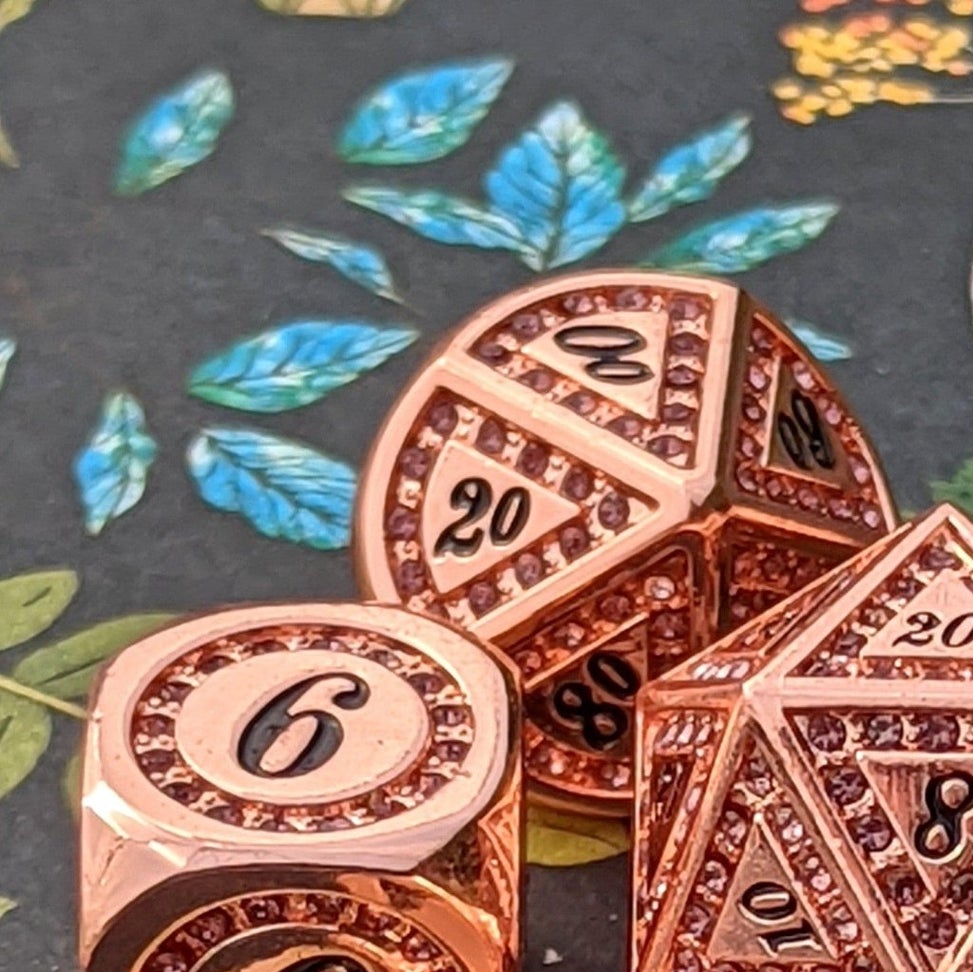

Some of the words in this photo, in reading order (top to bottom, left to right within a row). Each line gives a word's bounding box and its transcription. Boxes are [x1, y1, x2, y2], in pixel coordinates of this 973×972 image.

[553, 325, 654, 384] 00
[434, 477, 531, 558] 20
[237, 672, 370, 778] 6
